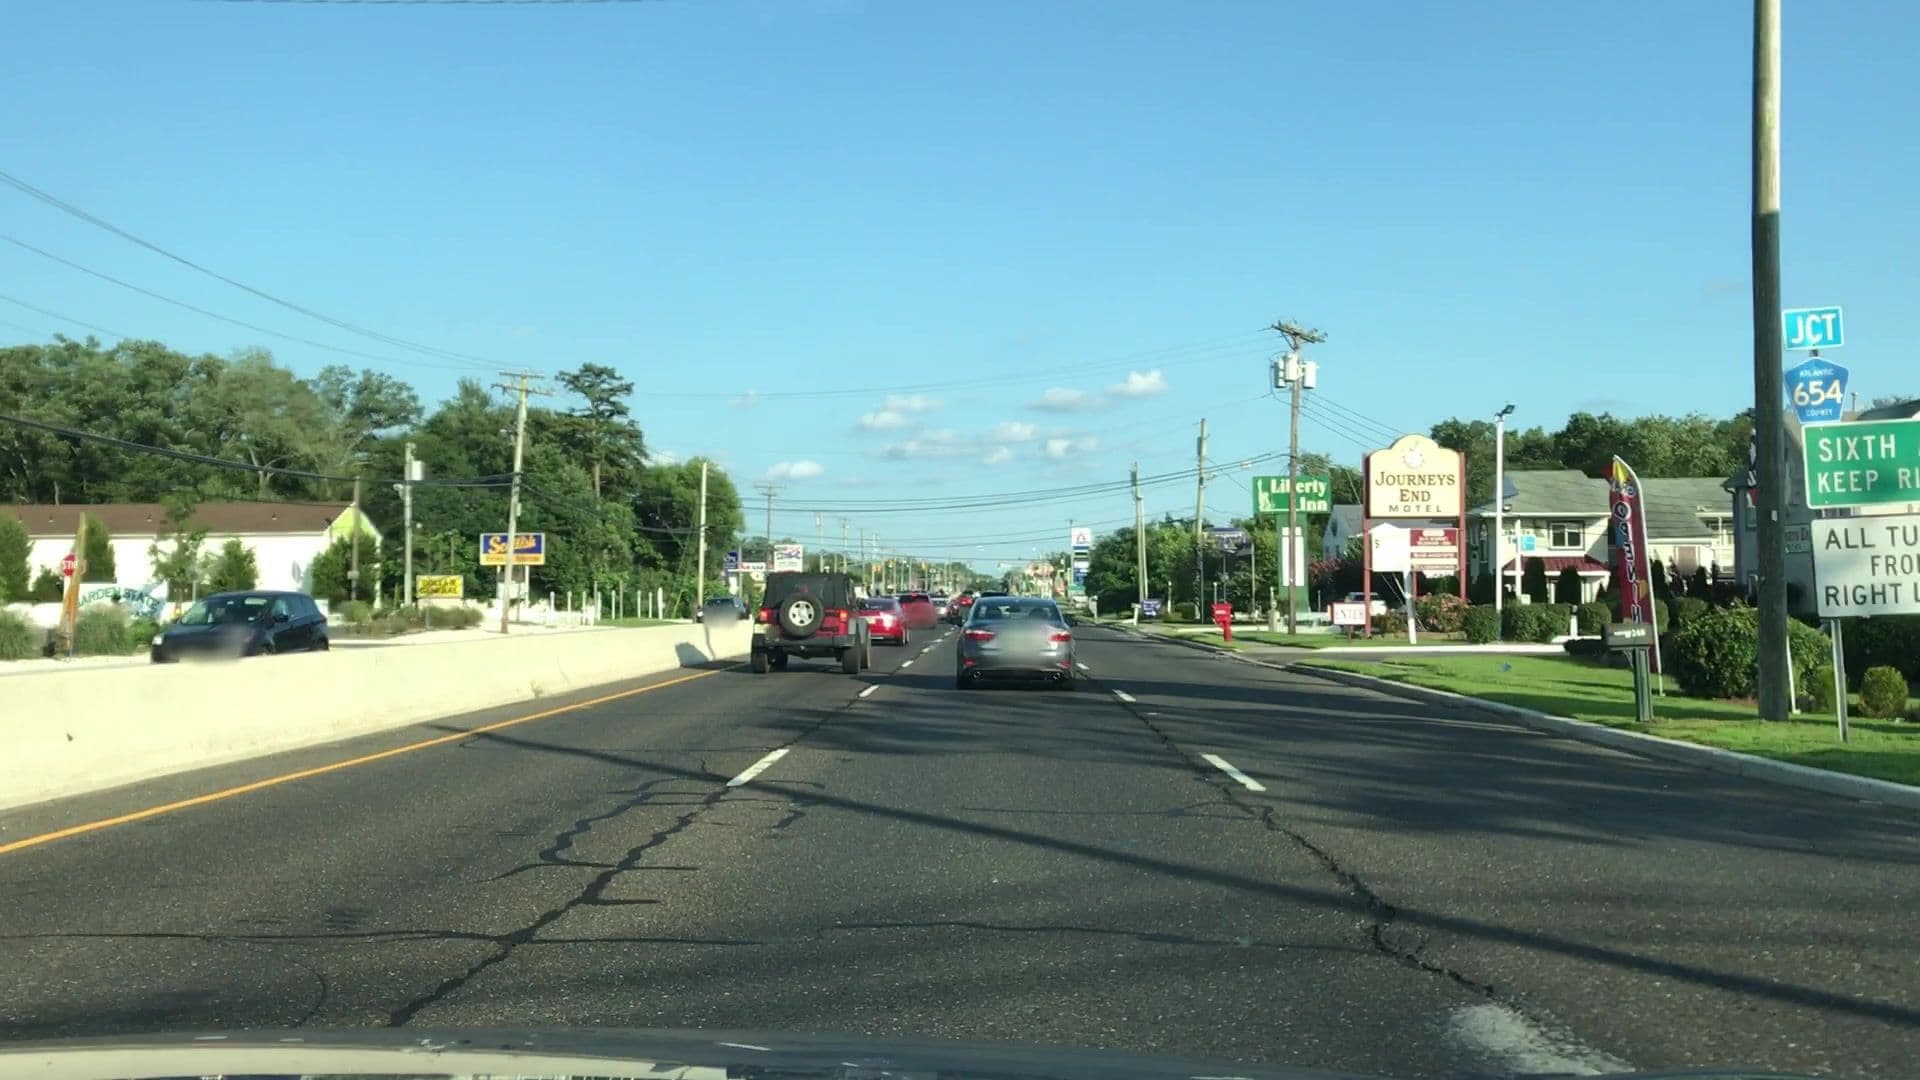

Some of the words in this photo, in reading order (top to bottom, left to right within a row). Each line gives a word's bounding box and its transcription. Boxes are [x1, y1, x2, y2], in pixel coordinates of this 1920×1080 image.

[1791, 313, 1836, 344] JCT
[1799, 368, 1835, 377] ATLANTIC
[1793, 379, 1843, 406] 654
[1805, 408, 1833, 417] COUNTY
[1818, 434, 1896, 462] SIXTH
[1375, 471, 1456, 486] JOURNEYS
[1817, 469, 1879, 493] KEEP
[1300, 496, 1329, 512] Inn
[1399, 489, 1431, 502] END
[1388, 504, 1443, 513] MOTEL
[1825, 527, 1876, 550] ALL
[1825, 583, 1902, 606] RIGHT
